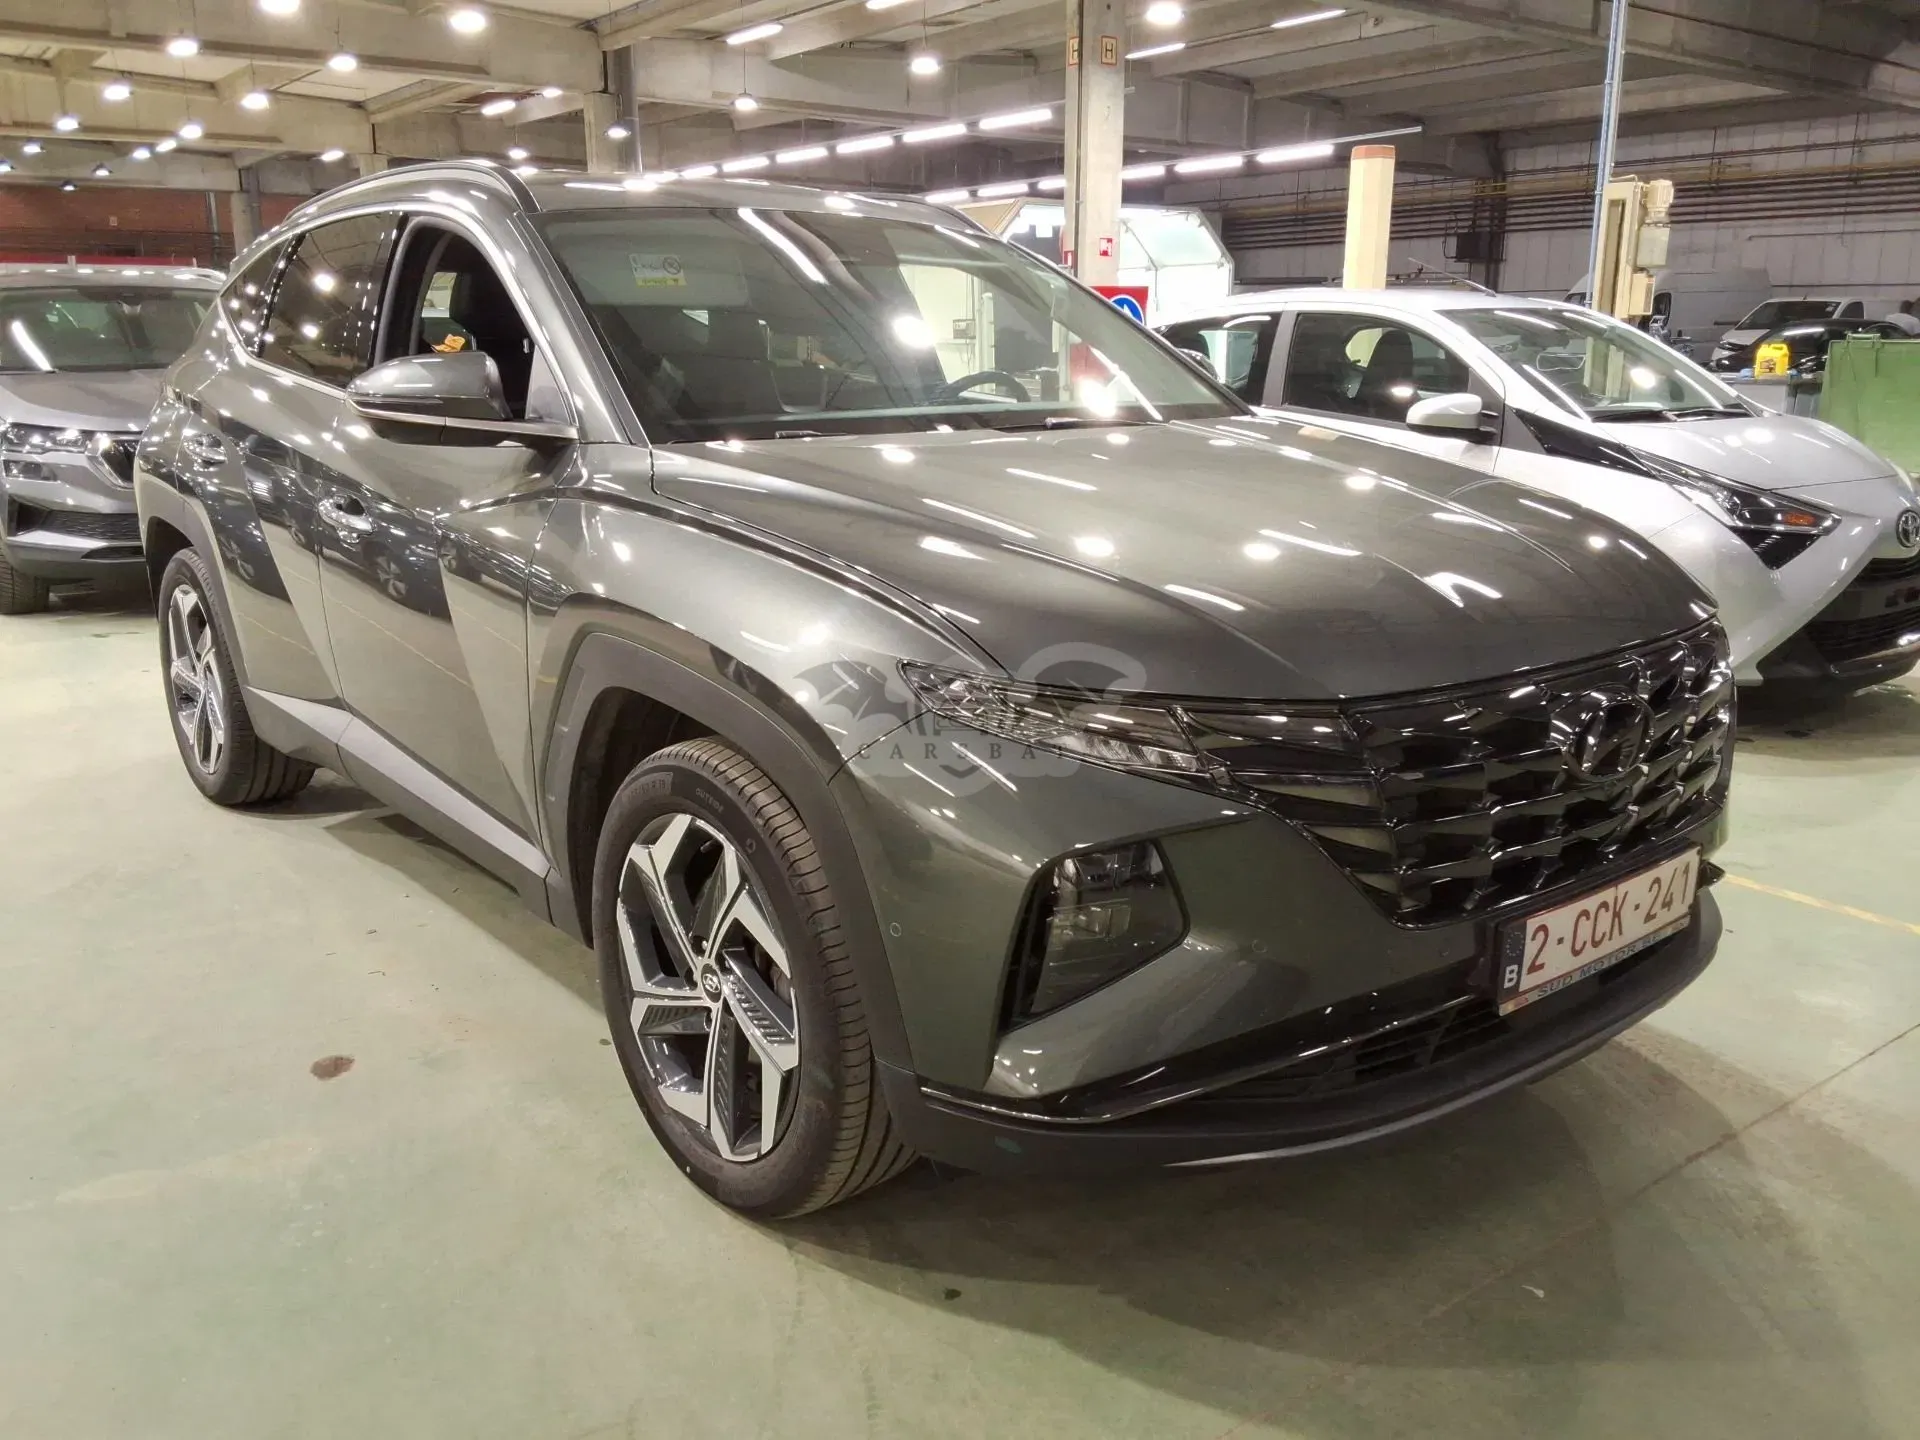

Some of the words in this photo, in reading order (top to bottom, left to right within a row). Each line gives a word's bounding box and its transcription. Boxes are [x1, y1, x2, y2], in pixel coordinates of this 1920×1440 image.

[1104, 41, 1114, 59] H
[1526, 861, 1691, 976] 2-CCK-241
[1503, 964, 1519, 989] B
[1536, 974, 1574, 998] SUD
